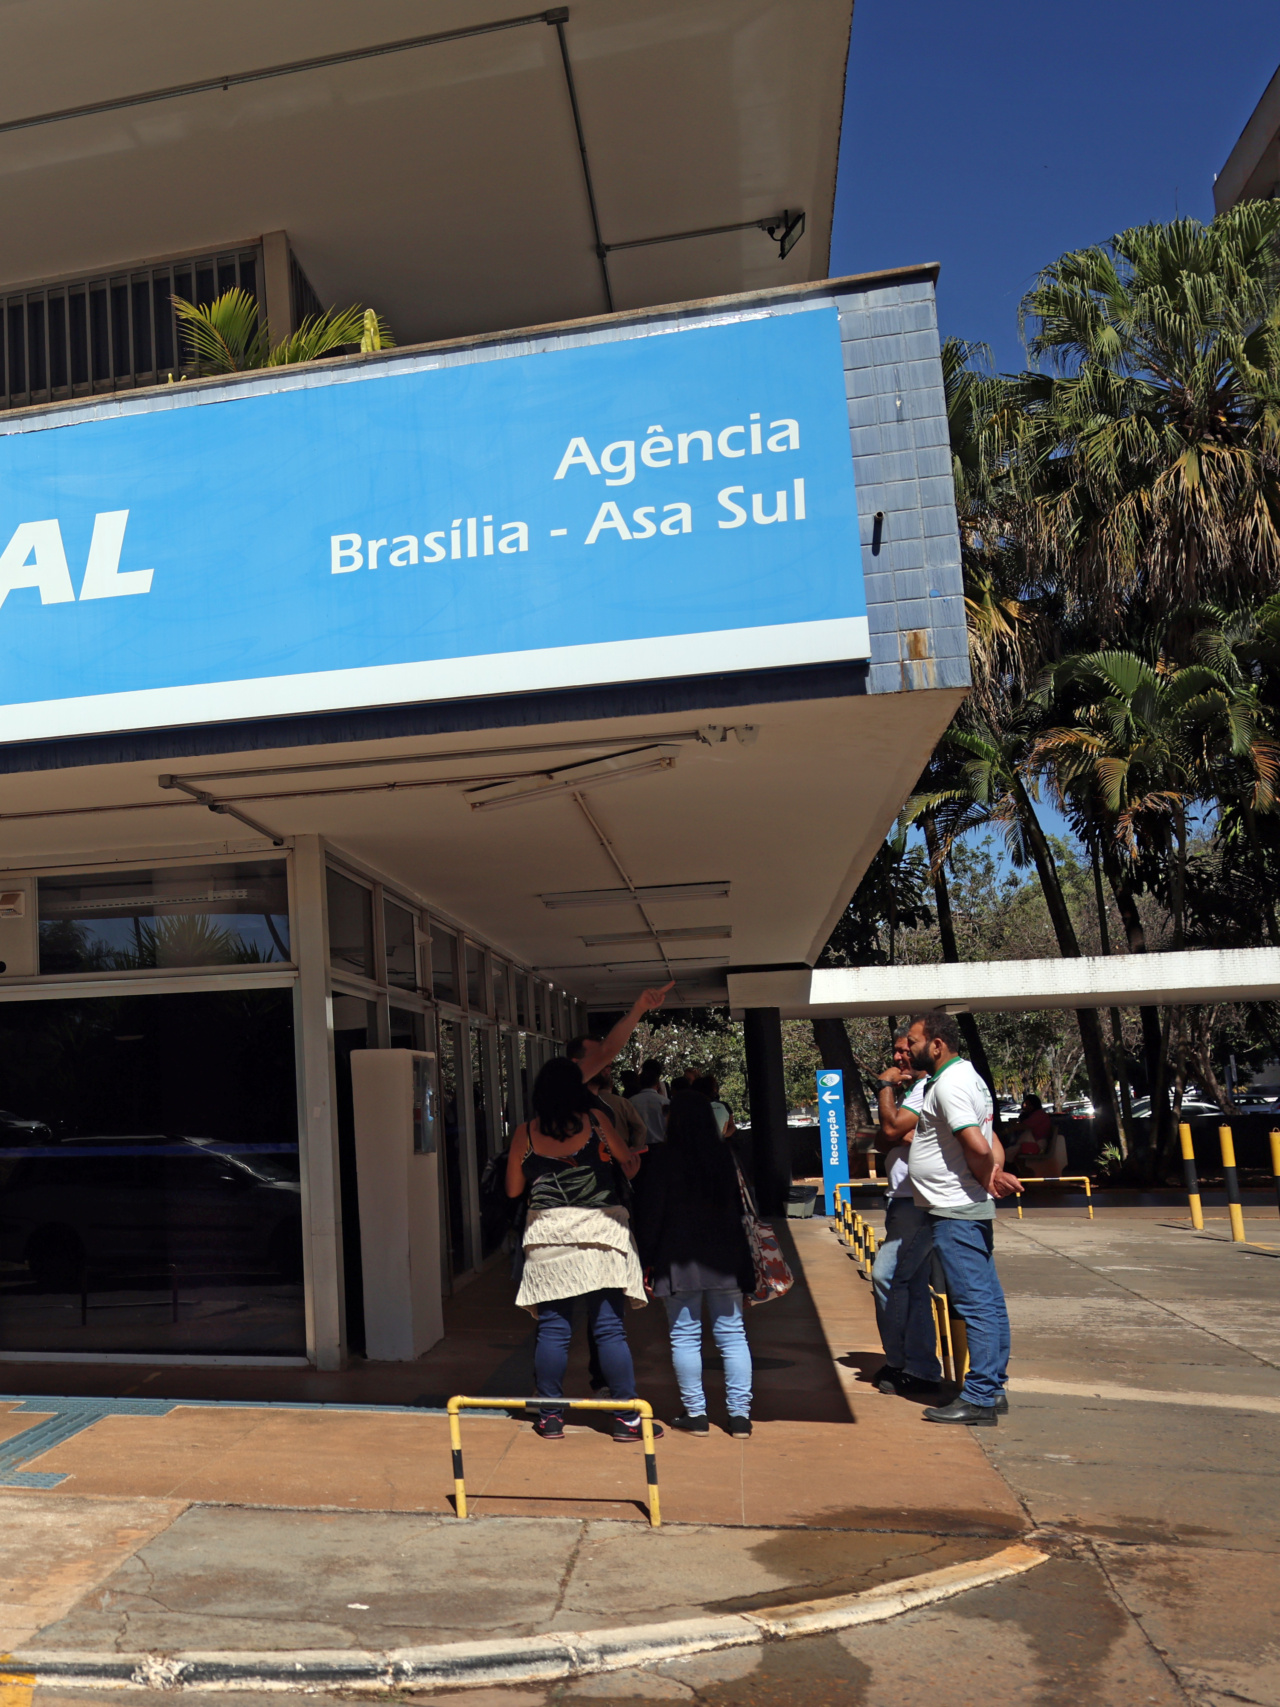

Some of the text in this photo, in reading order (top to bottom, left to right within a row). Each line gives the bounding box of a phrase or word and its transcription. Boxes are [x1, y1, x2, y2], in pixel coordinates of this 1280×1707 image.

[554, 413, 800, 487] Agência
[331, 515, 529, 575] Brasília
[584, 501, 693, 545] Asa
[718, 478, 806, 529] Sul
[827, 1109, 840, 1166] Recepção
